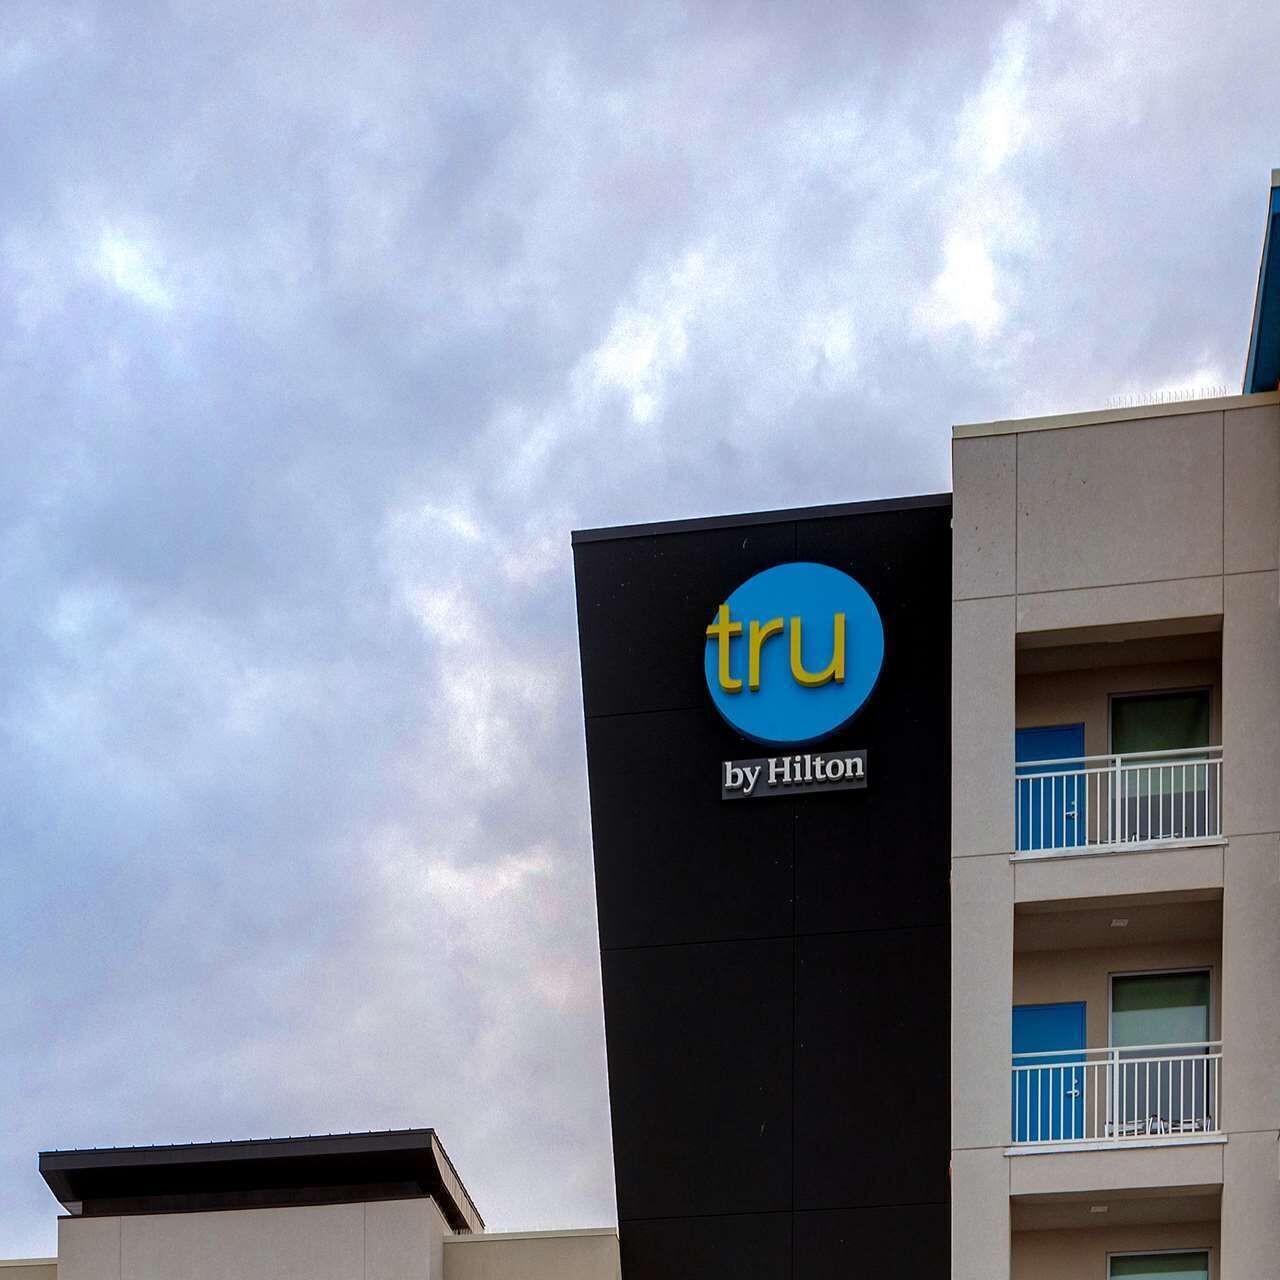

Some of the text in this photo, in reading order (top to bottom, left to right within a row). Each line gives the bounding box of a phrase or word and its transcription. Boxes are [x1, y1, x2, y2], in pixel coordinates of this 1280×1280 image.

[706, 604, 846, 693] tru
[724, 754, 865, 795] by Hilton
